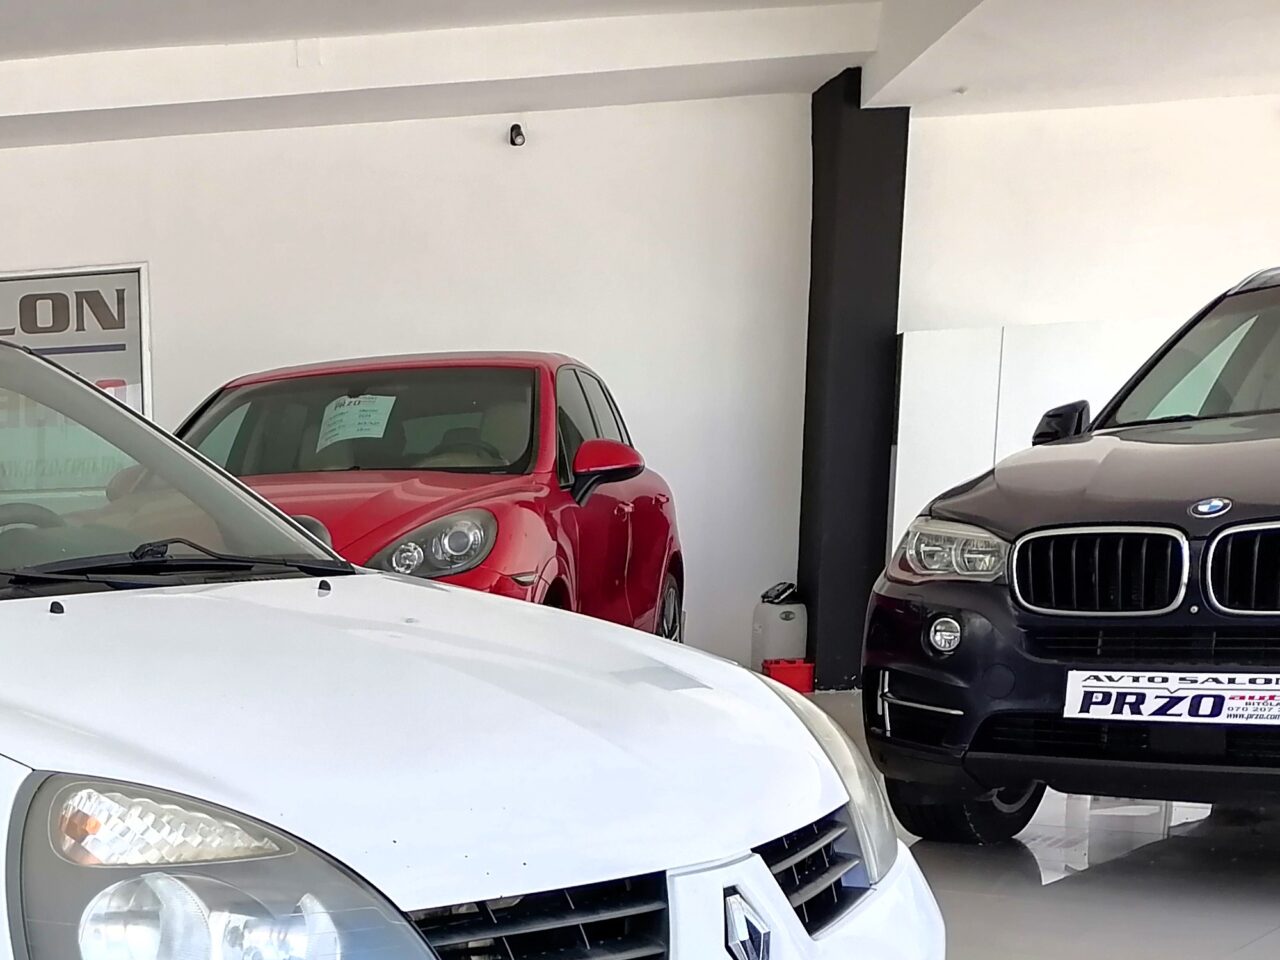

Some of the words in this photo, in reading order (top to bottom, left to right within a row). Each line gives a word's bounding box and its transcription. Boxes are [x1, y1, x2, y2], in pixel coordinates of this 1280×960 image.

[1082, 674, 1169, 684] AVTO
[1178, 677, 1280, 685] SALO
[1078, 690, 1226, 718] PRZO
